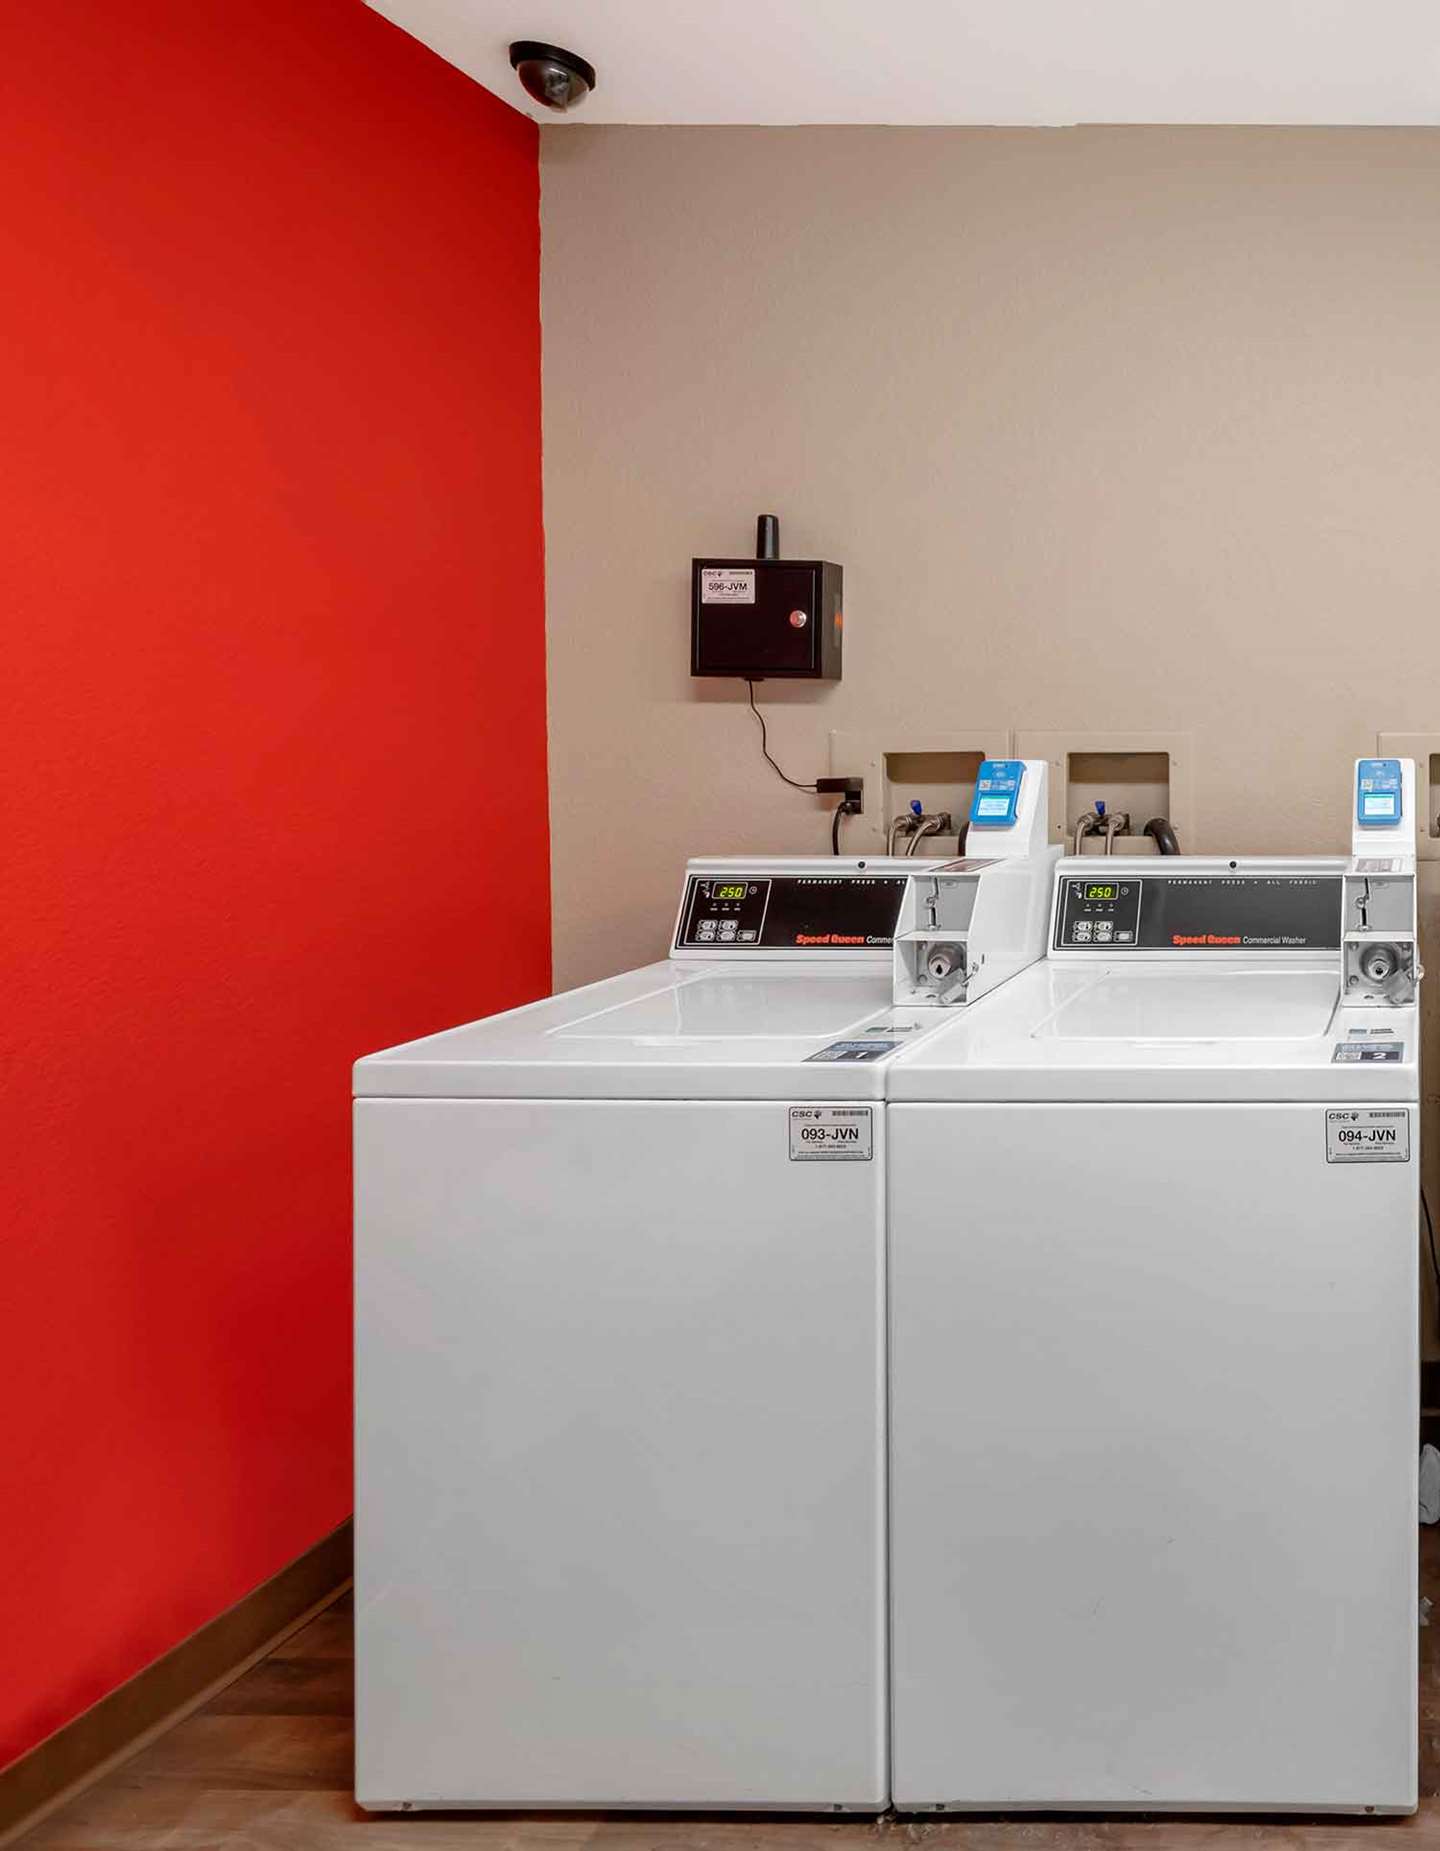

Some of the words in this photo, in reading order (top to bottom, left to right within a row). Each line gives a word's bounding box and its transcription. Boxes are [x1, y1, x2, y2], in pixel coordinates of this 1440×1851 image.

[796, 933, 831, 945] Speed
[831, 933, 865, 944] Queen
[1172, 934, 1206, 946] Speed
[1207, 934, 1241, 944] Queen
[1242, 935, 1281, 945] Commercial
[1282, 935, 1307, 945] Washer
[791, 1110, 813, 1118] CSC
[1328, 1112, 1350, 1120] CSC
[801, 1128, 859, 1140] 093-JVN
[1338, 1129, 1396, 1142] 094-JVN
